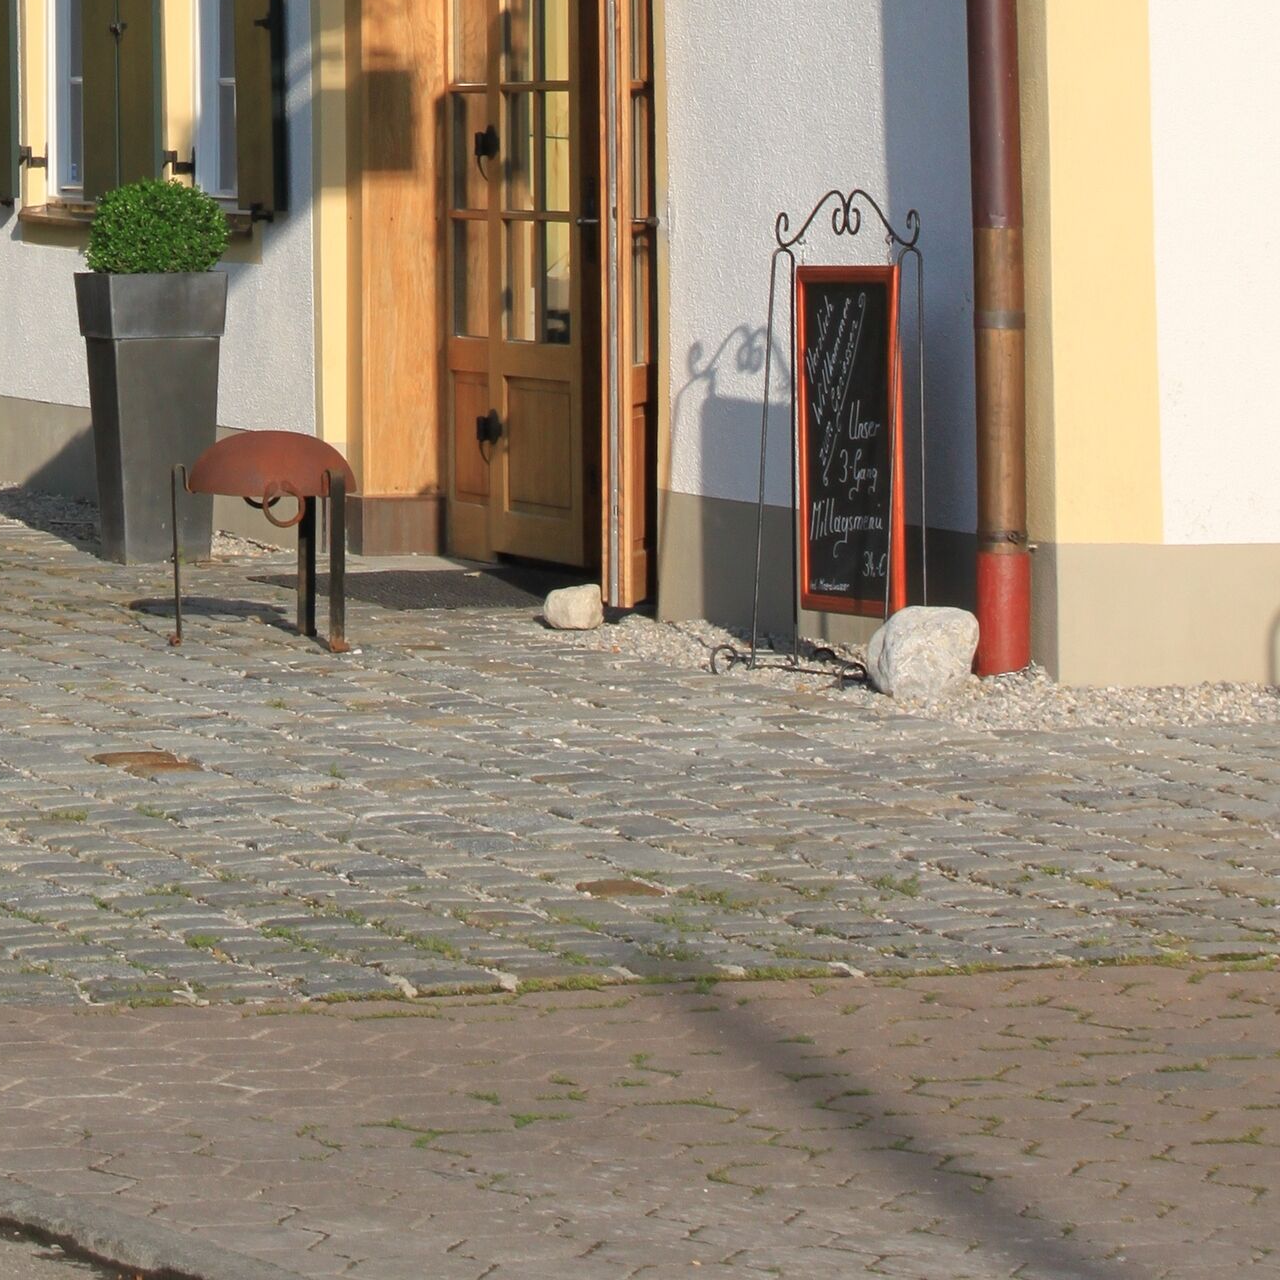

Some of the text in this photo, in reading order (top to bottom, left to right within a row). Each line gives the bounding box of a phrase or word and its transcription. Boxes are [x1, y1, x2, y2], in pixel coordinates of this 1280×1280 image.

[806, 294, 835, 385] Herzlich
[812, 297, 852, 426] Willkommen
[848, 399, 881, 440] Unser
[838, 448, 879, 500] 3-Gang
